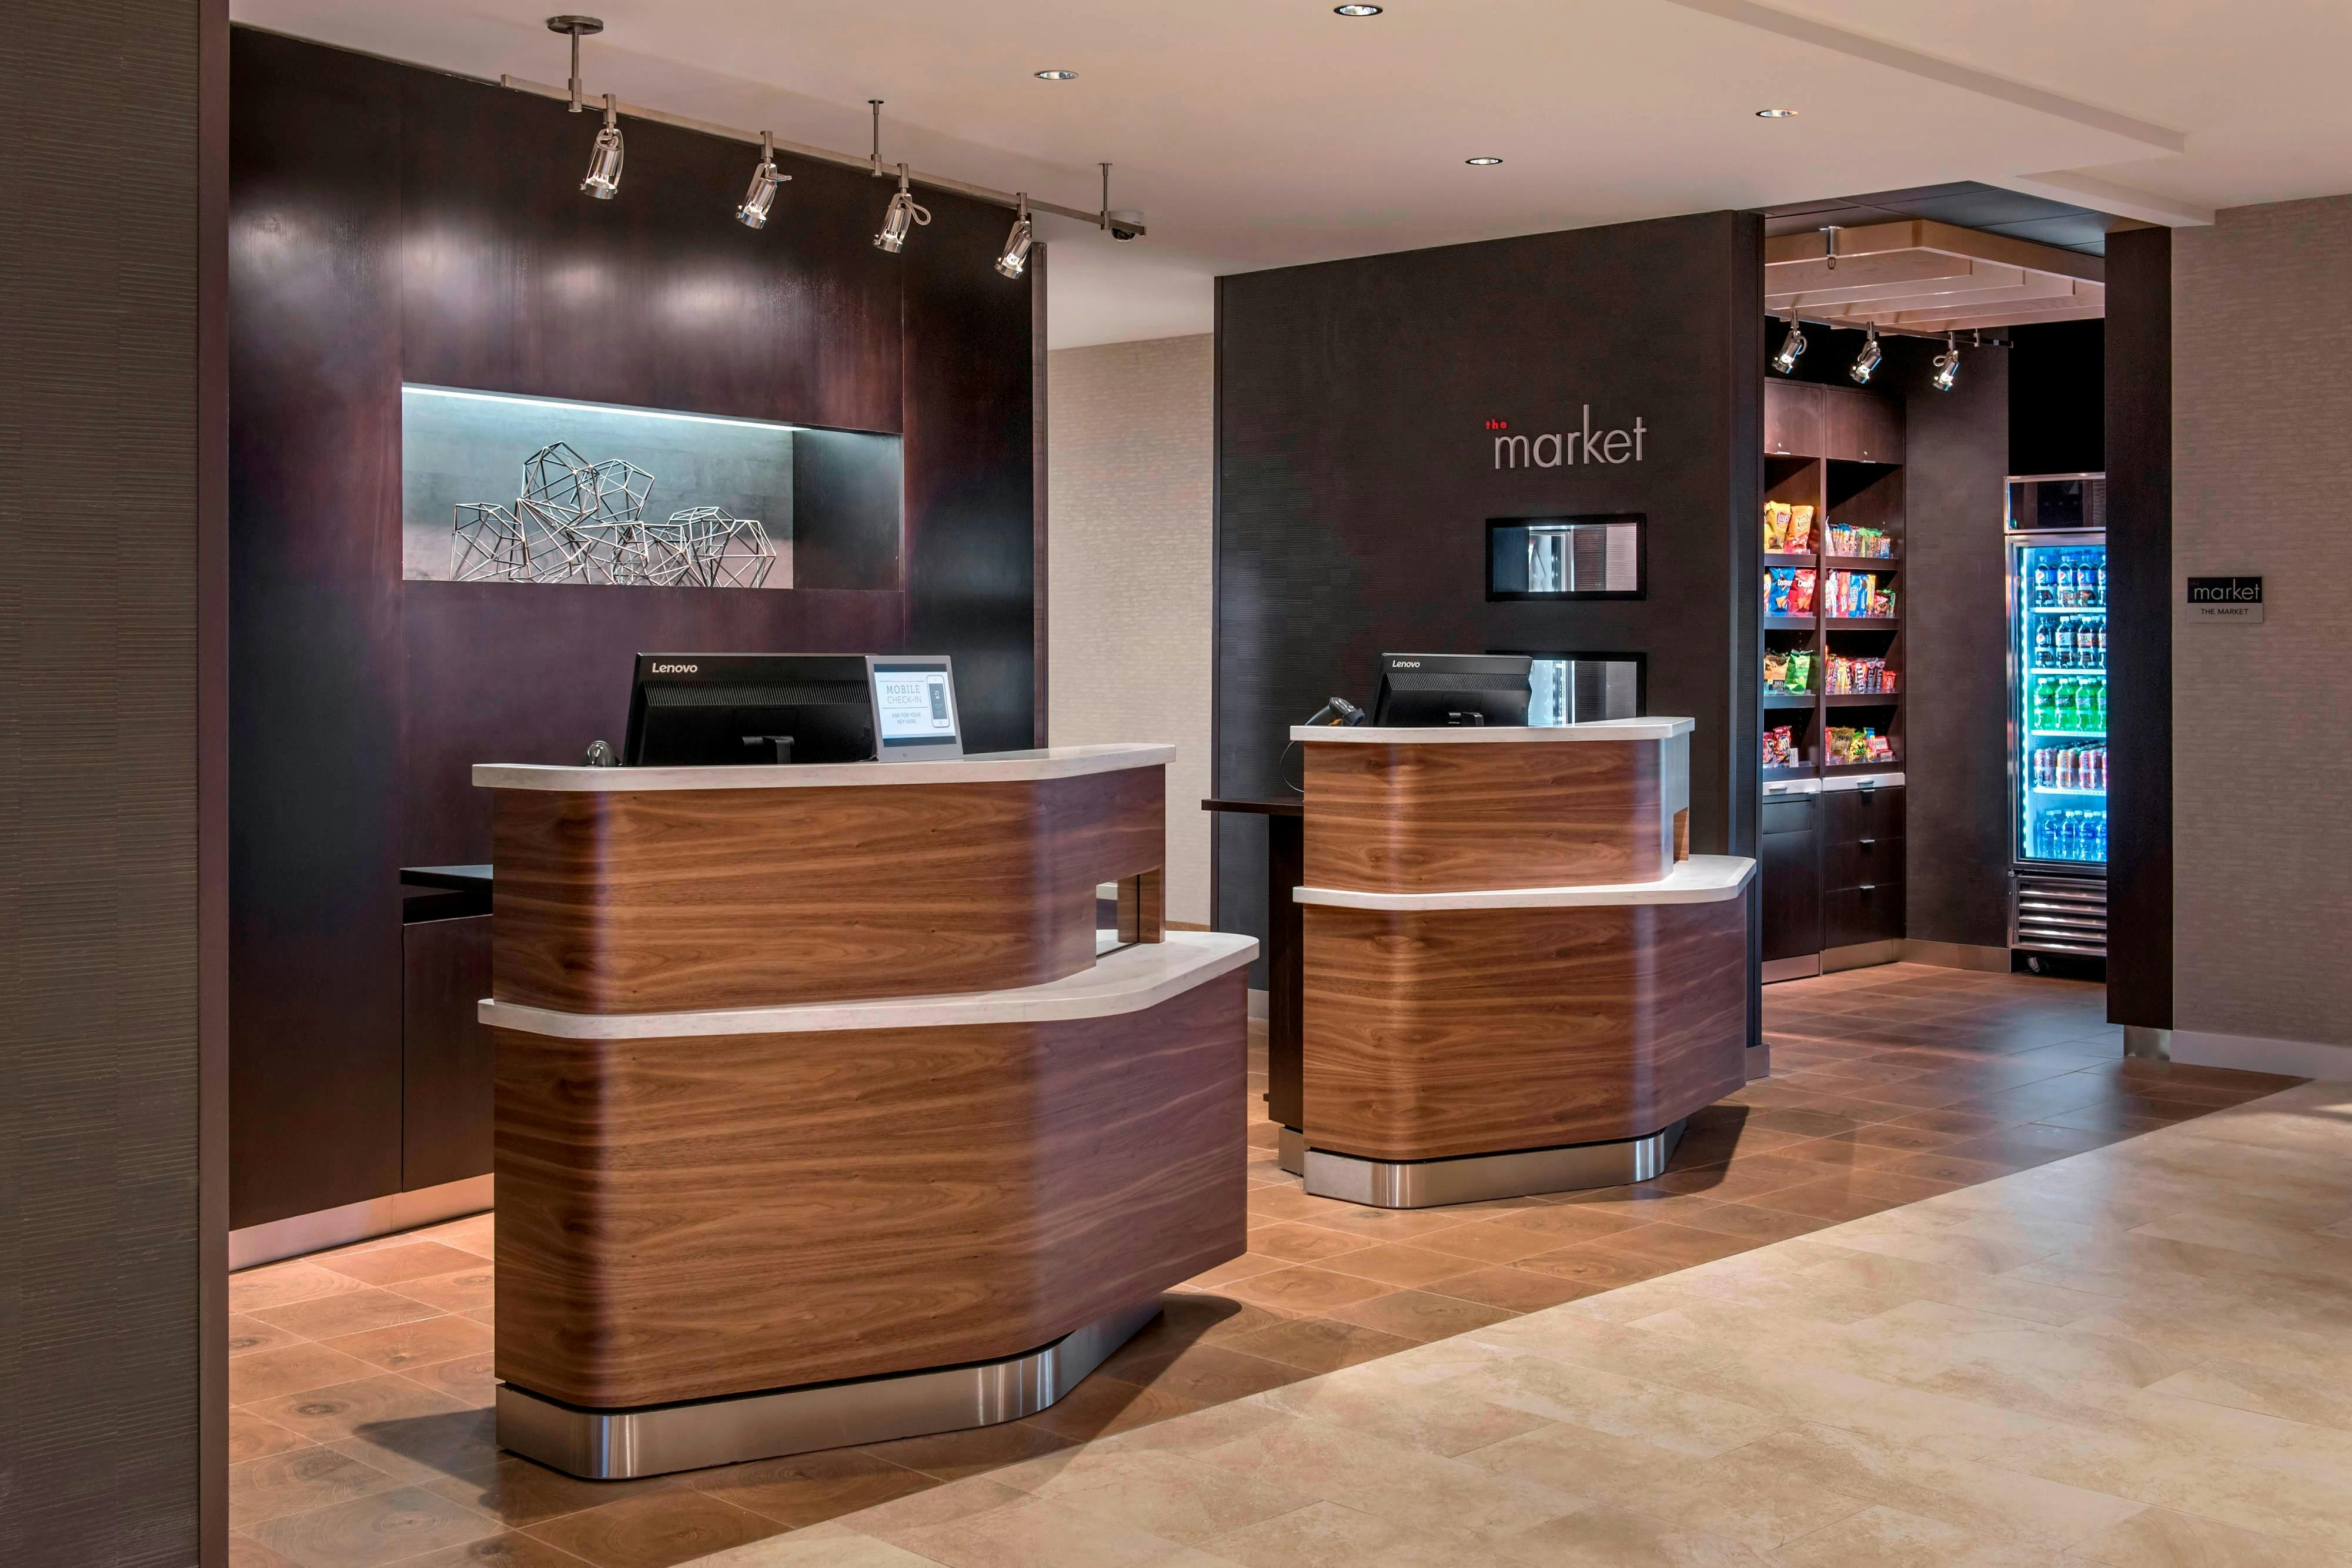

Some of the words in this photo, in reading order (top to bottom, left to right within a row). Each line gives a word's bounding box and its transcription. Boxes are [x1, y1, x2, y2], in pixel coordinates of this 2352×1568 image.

[1486, 419, 1507, 430] the
[1495, 404, 1647, 469] market
[2194, 578, 2260, 600] market
[652, 663, 698, 673] Lenovo
[1392, 660, 1420, 668] Lenovo
[886, 685, 921, 694] MOBILE
[887, 696, 922, 704] CHECK-IN
